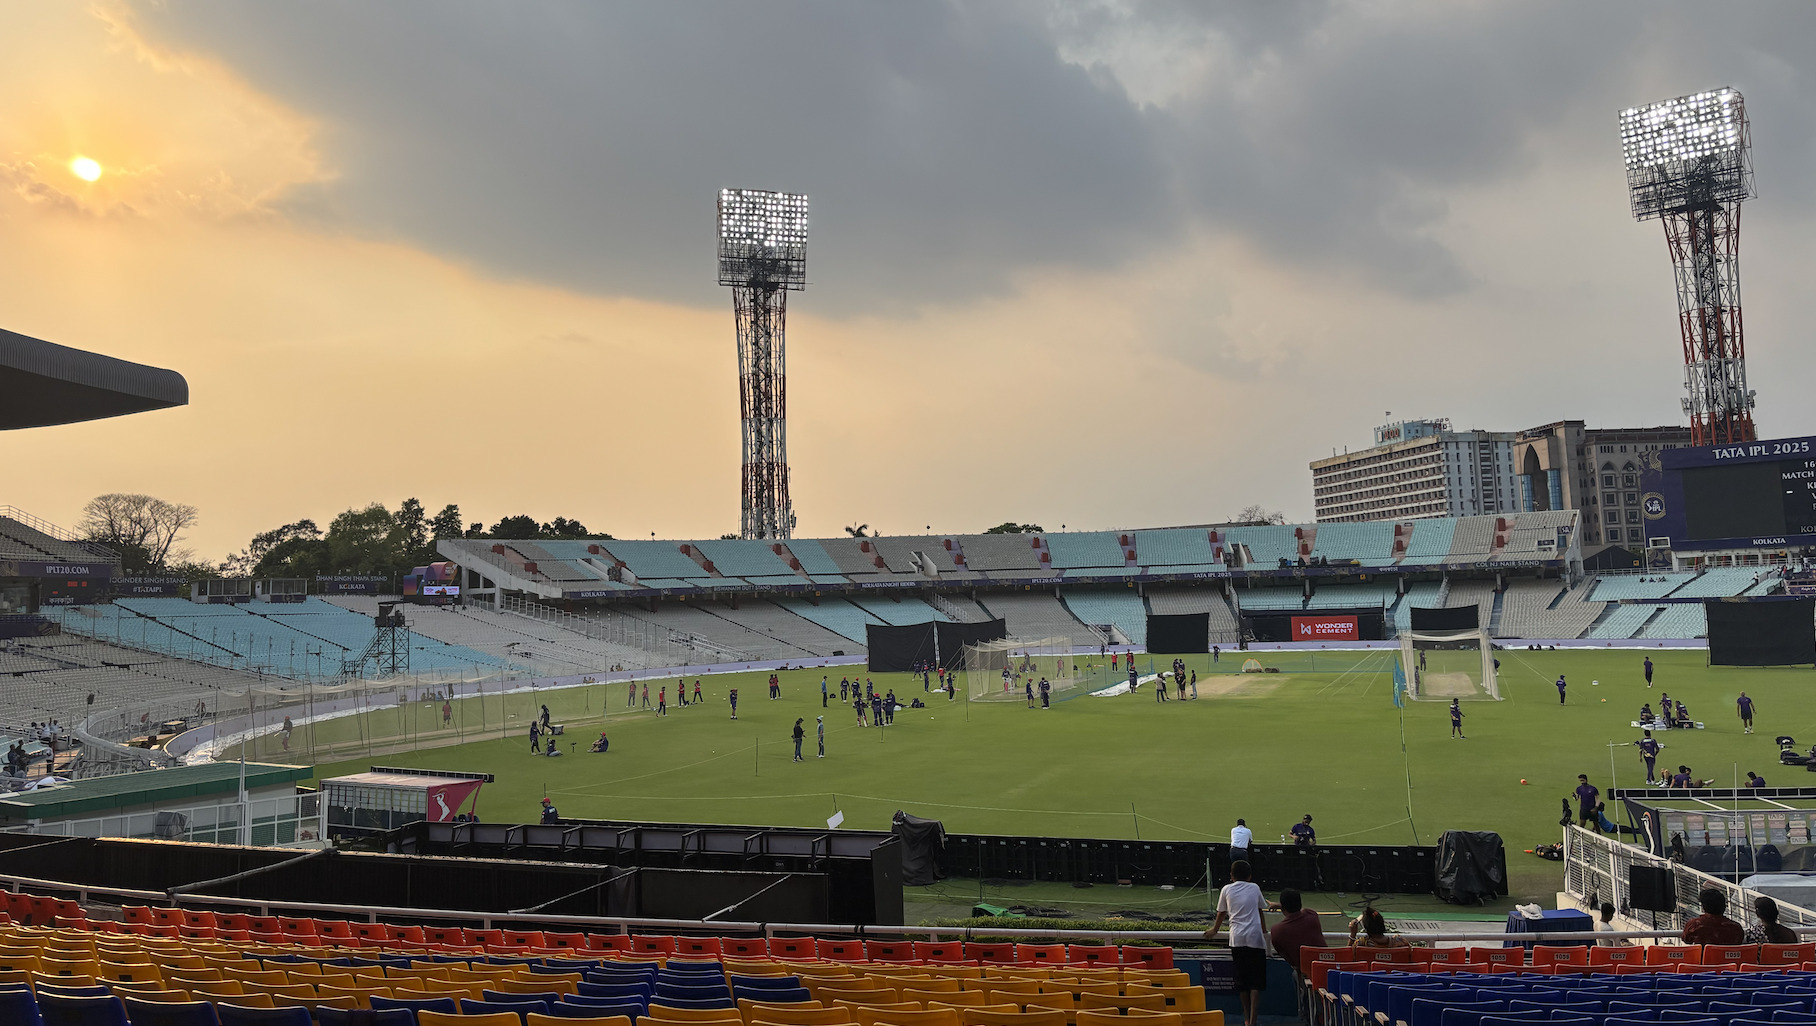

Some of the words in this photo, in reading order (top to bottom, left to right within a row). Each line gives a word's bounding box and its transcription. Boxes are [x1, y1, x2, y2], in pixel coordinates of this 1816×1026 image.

[1712, 446, 1746, 460] TATA
[1749, 445, 1770, 457] IPL
[1773, 441, 1810, 455] 2025
[1782, 470, 1814, 480] MATCH
[1752, 537, 1787, 546] KOLKATA
[45, 565, 90, 575] IPLT20.COM
